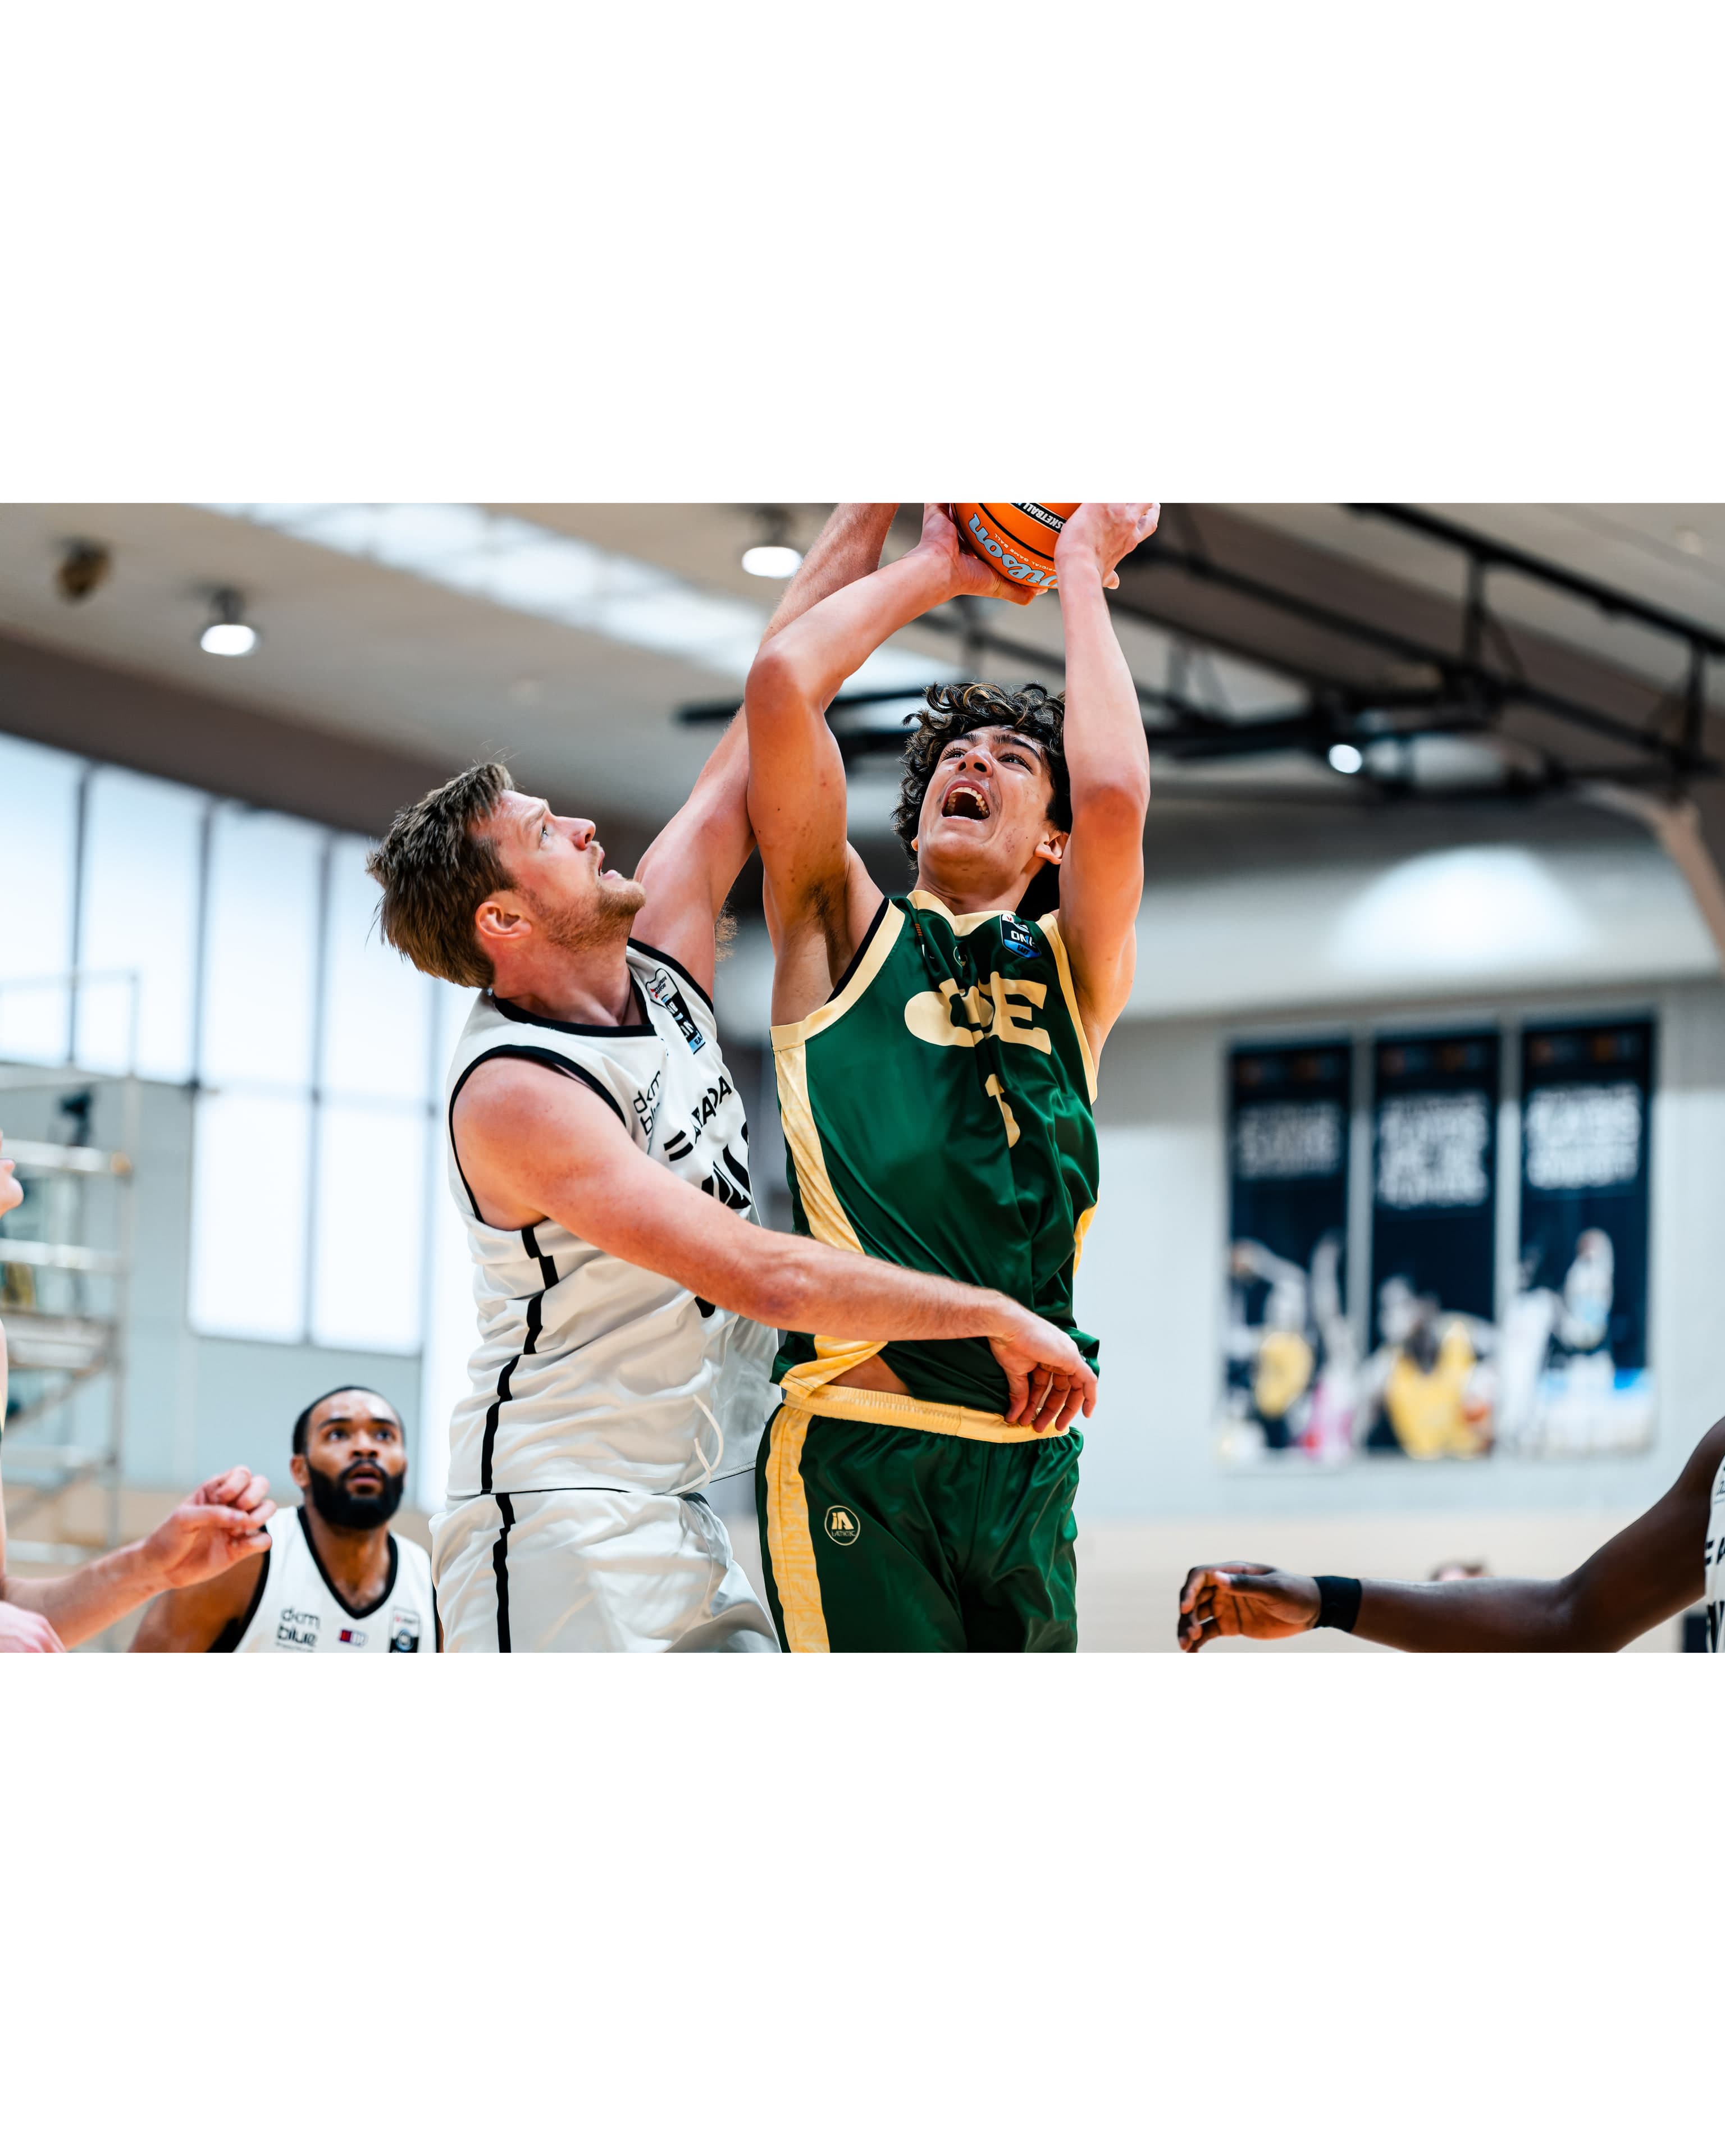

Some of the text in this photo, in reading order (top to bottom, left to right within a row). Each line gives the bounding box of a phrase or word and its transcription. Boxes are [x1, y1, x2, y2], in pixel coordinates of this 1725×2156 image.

[1023, 503, 1065, 530] SKETBALL
[994, 533, 1009, 549] BALL
[1010, 549, 1029, 562] GAME
[278, 1625, 315, 1647] blue
